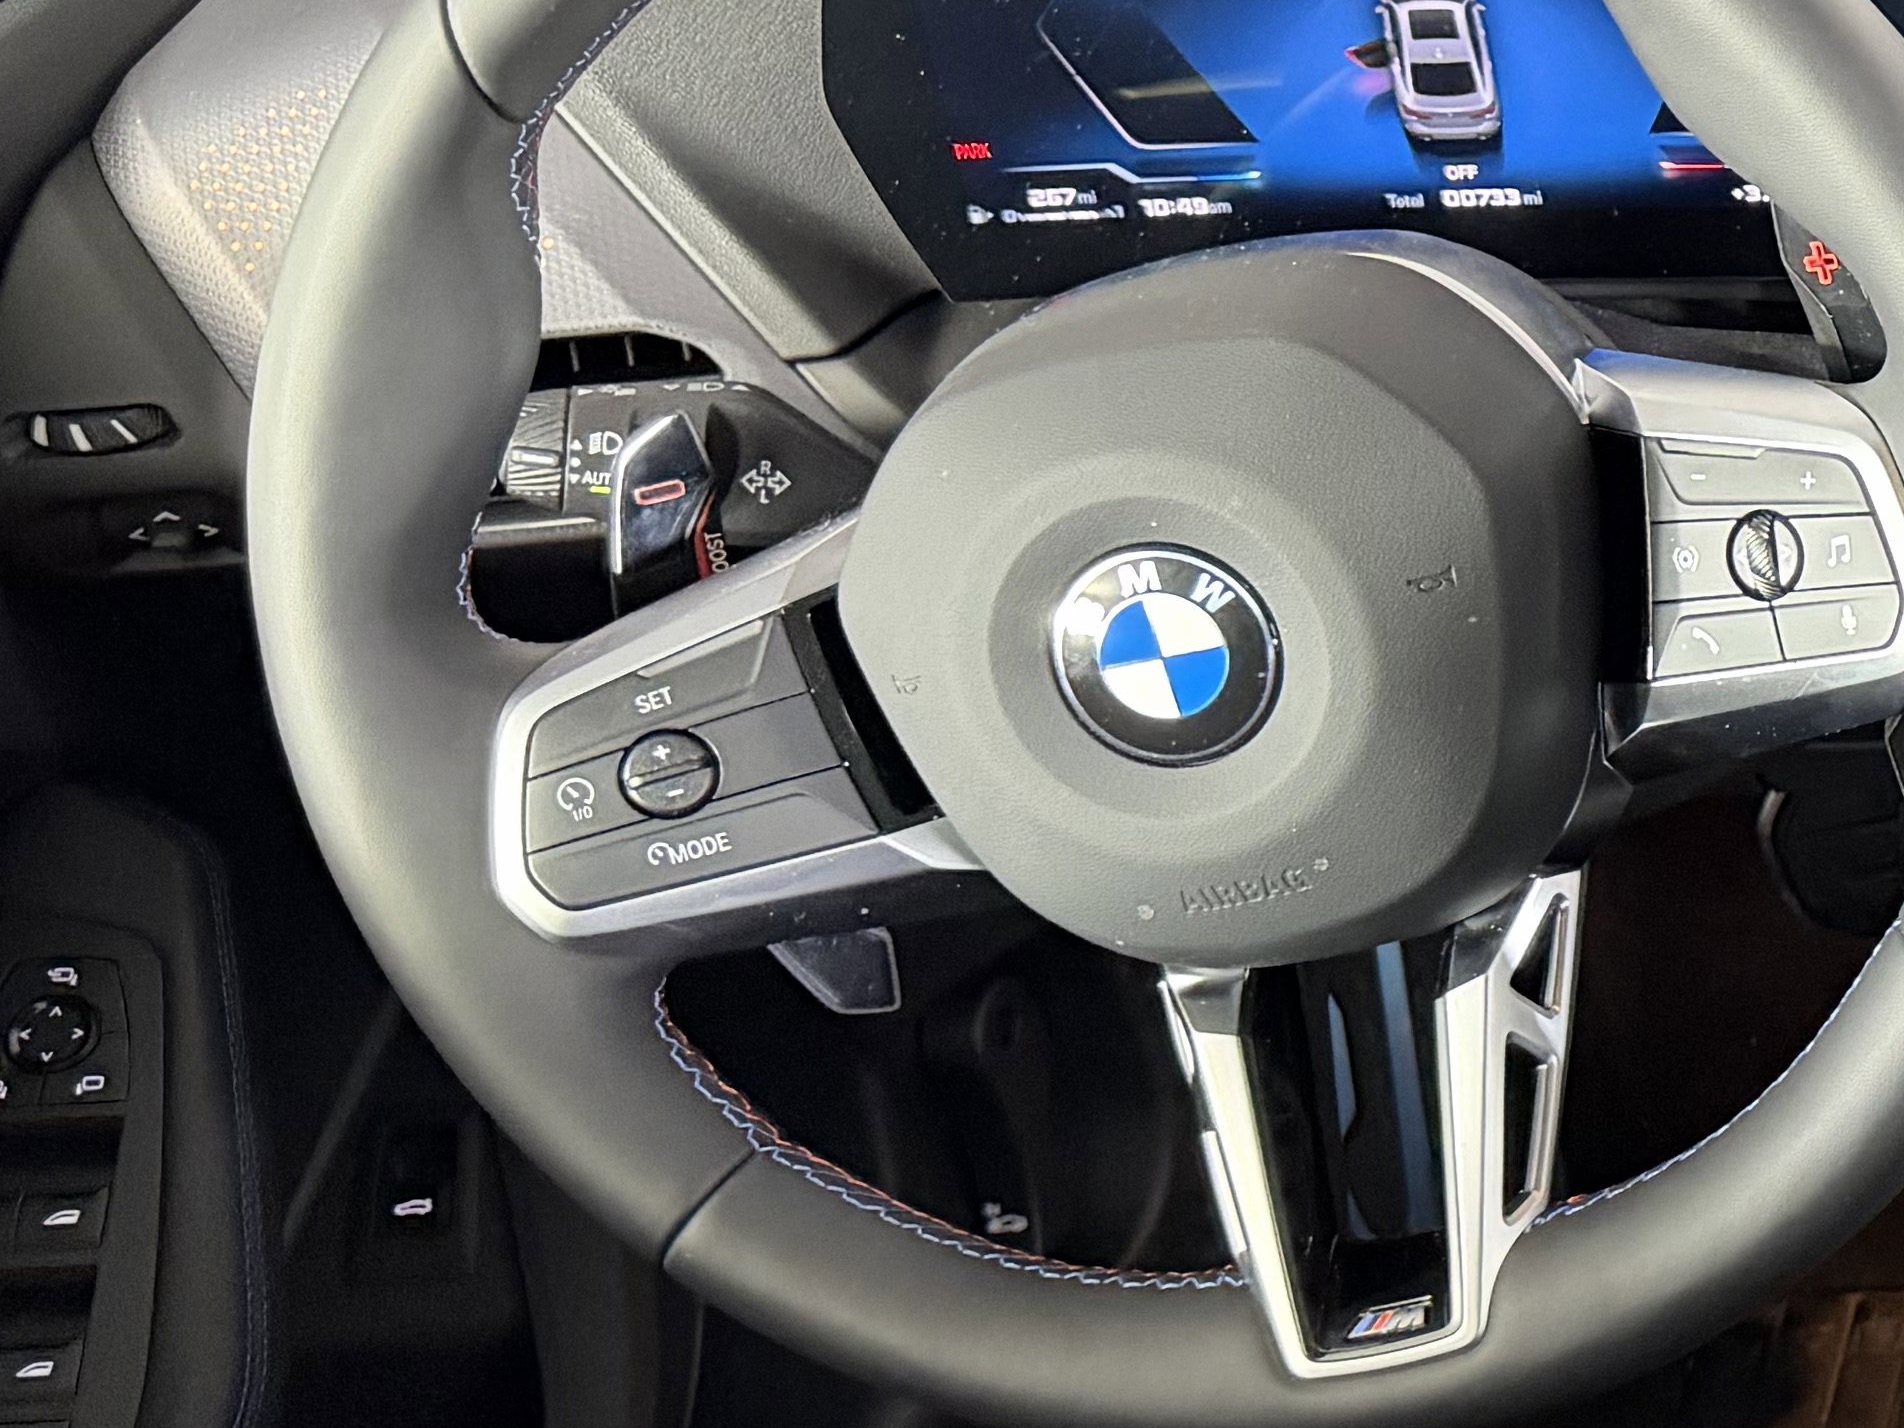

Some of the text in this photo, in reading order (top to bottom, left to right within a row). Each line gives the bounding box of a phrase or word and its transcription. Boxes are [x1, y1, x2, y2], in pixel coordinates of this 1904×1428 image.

[1443, 163, 1479, 181] OFF
[1384, 192, 1425, 209] Total
[761, 460, 771, 474] R
[581, 470, 612, 485] AUT
[759, 490, 770, 504] L
[634, 685, 674, 714] SET
[667, 831, 733, 865] MODE
[1179, 867, 1314, 915] AIRBAG
